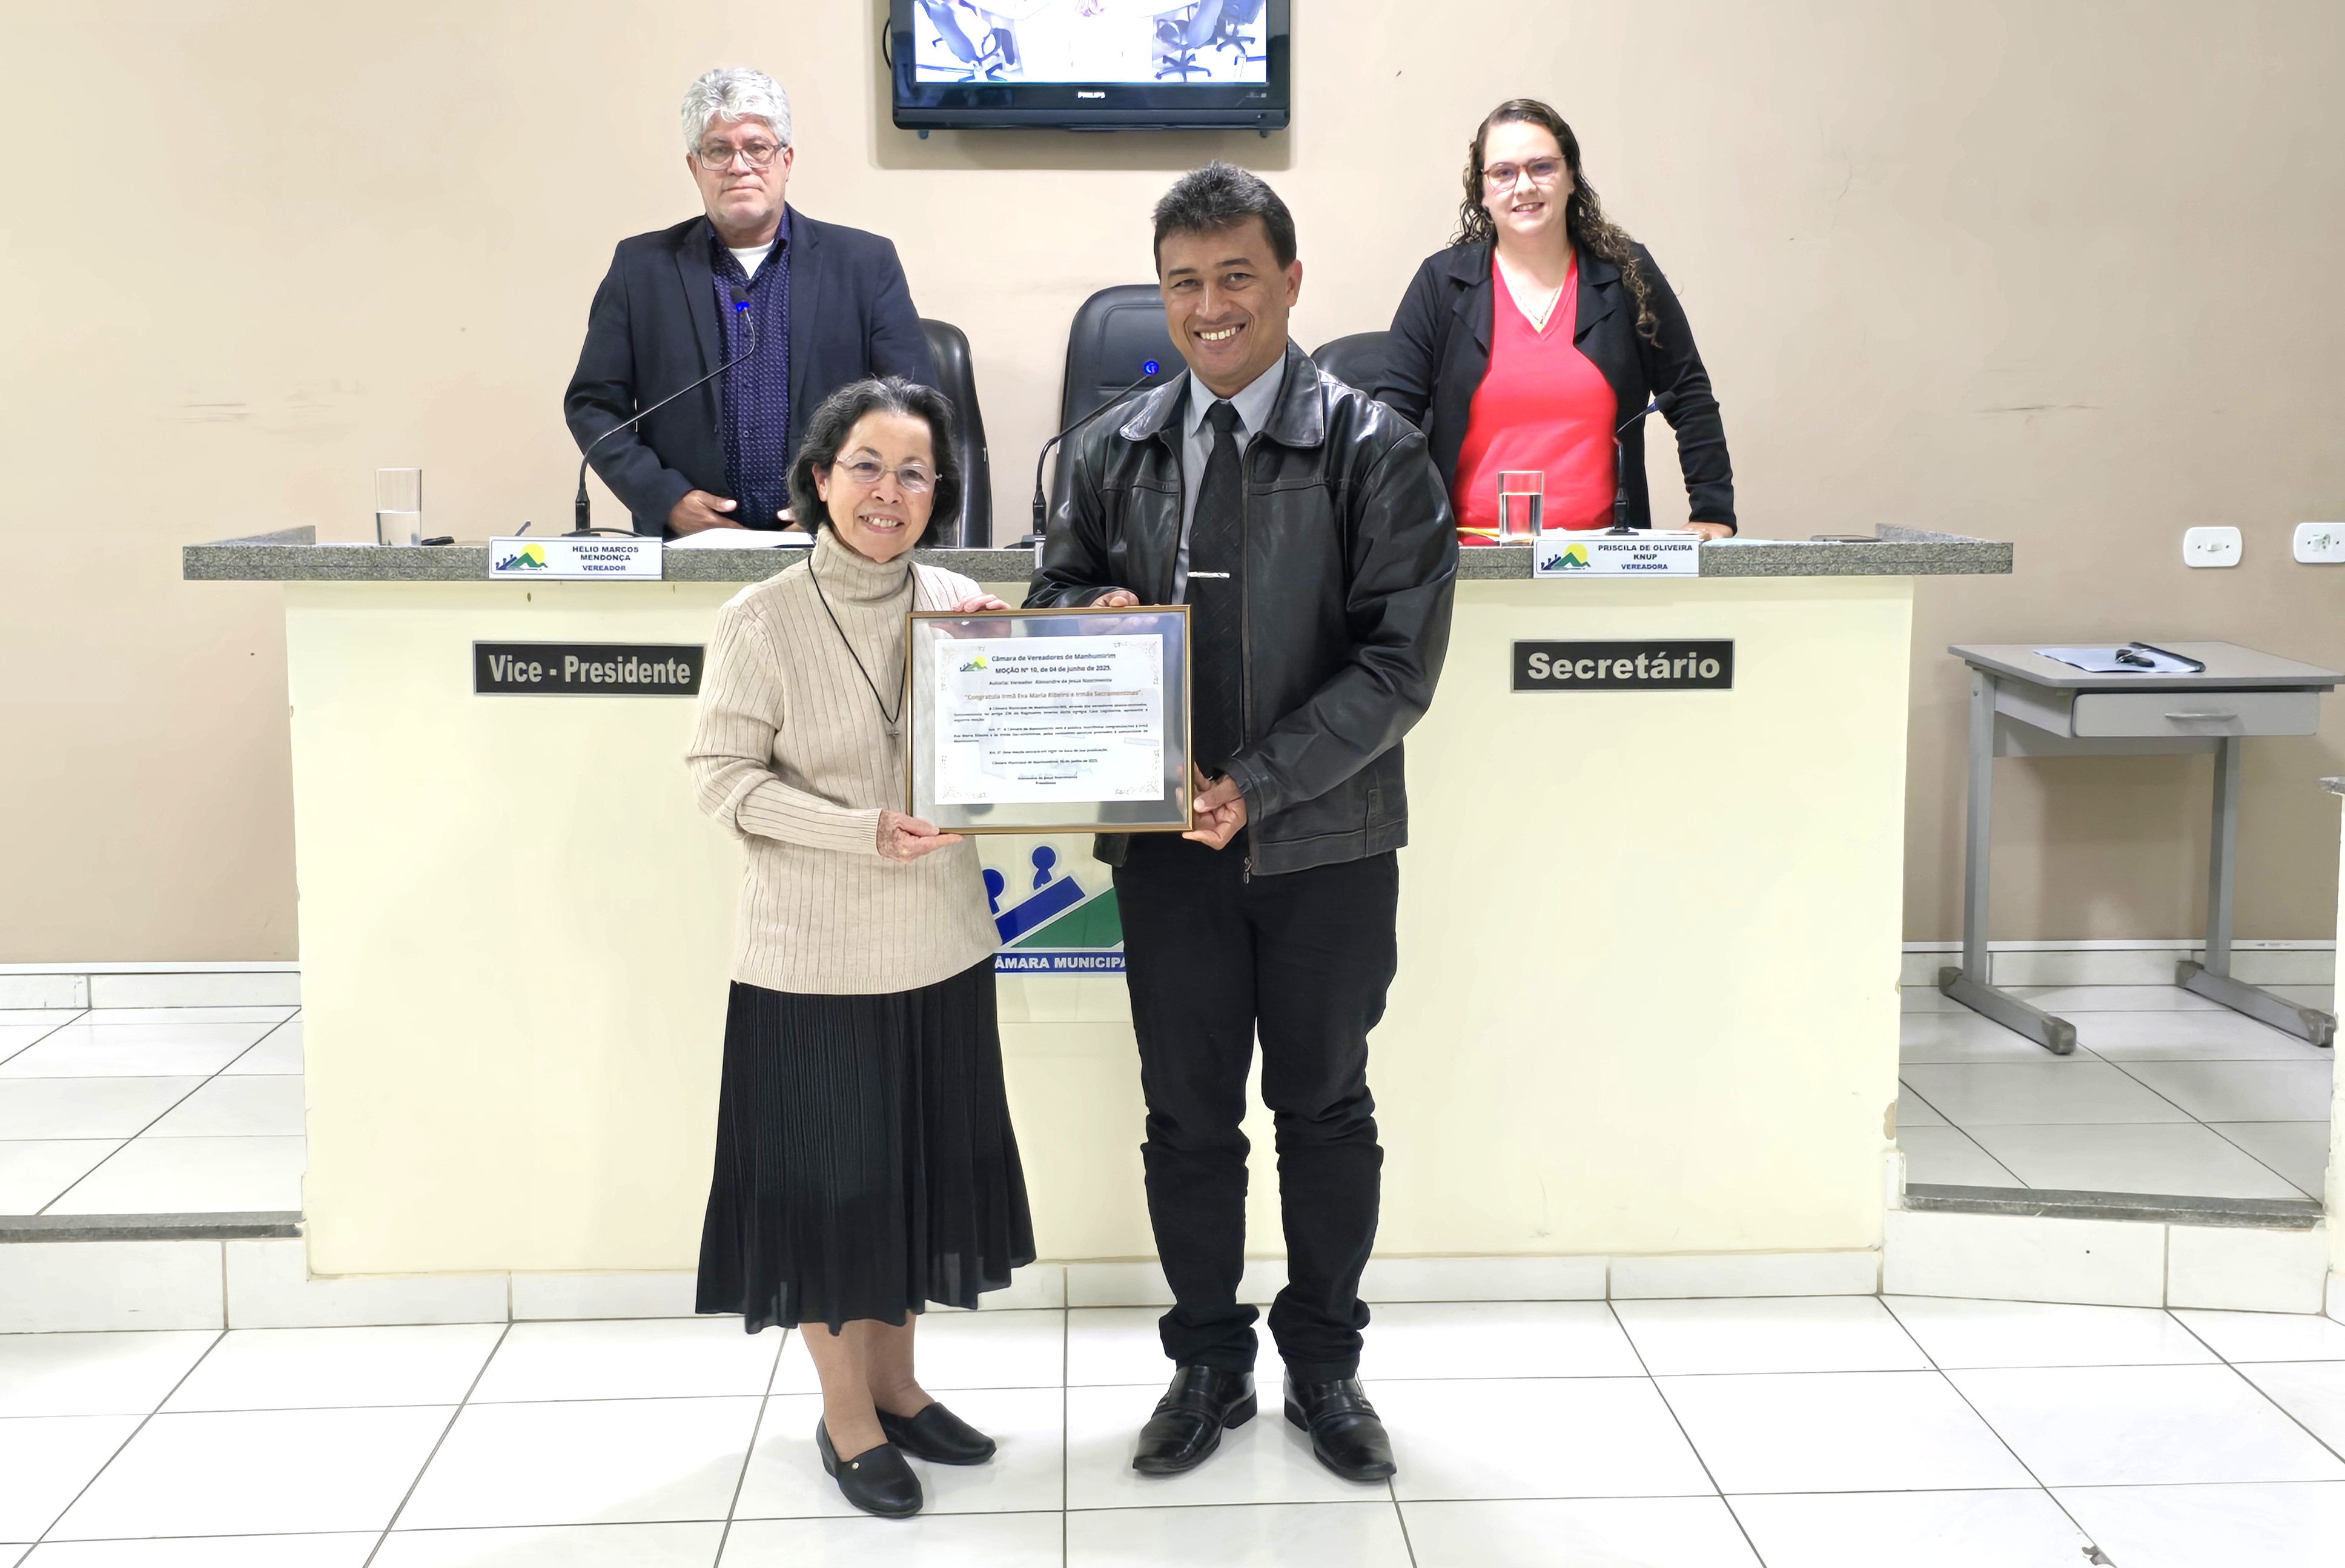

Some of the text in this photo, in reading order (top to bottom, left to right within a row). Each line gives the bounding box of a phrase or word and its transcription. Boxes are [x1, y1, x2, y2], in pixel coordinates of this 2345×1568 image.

[489, 655, 543, 683] Vice
[564, 655, 691, 684] Presidente
[1527, 652, 1720, 680] Secretário
[995, 955, 1126, 968] ÂMARA MUNICIPA
